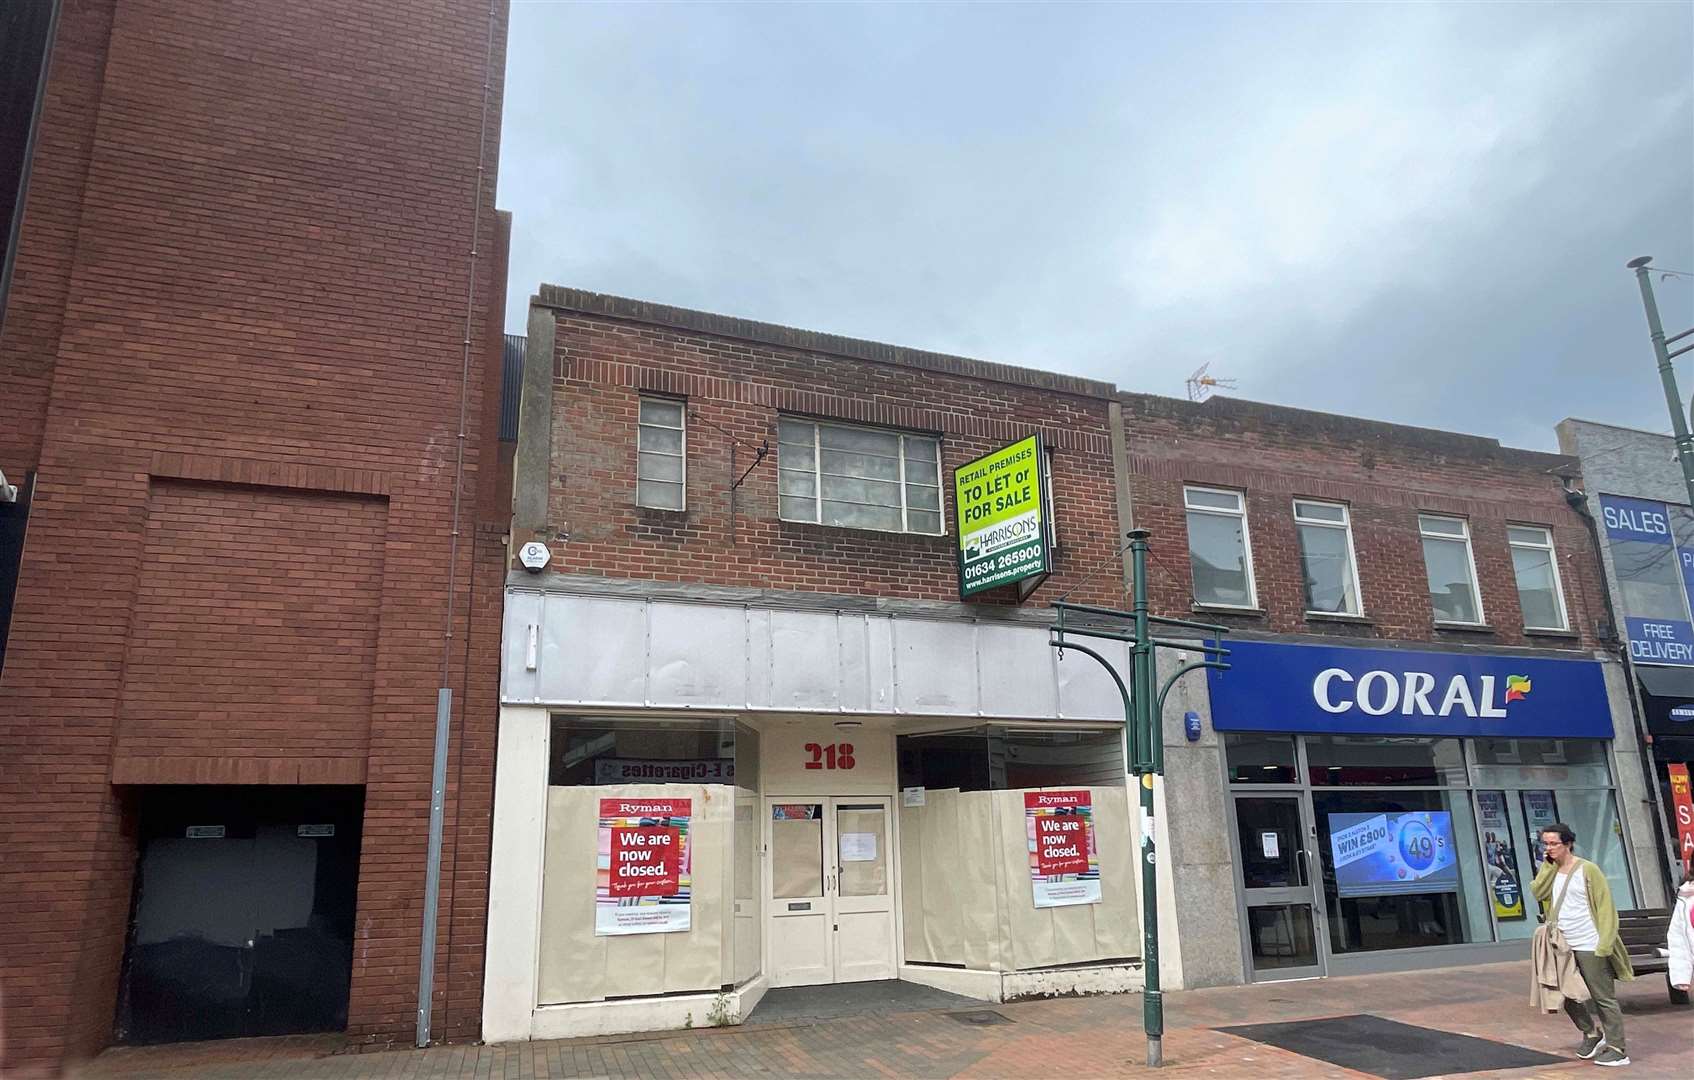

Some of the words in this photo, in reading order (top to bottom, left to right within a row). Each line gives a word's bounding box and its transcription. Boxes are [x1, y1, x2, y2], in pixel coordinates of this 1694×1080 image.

[959, 468, 987, 486] RETAIL
[989, 448, 1032, 474] PREMISES
[964, 485, 982, 504] TO
[987, 473, 1011, 496] LET
[1016, 468, 1030, 483] or
[965, 504, 991, 524] FOR
[996, 486, 1031, 513] SALE
[980, 516, 1037, 549] HARRISONS
[1604, 506, 1667, 535] SALES
[965, 558, 995, 579] 01634
[998, 546, 1041, 569] 265900
[966, 560, 1042, 589] www.harrisons.property
[1643, 623, 1675, 640] FREE
[1630, 640, 1694, 661] DELIVERY
[1313, 668, 1507, 718] CORAL
[804, 743, 856, 770] 218
[619, 803, 673, 814] Ryman
[1039, 795, 1077, 804] Ryman
[1042, 820, 1060, 832] We
[1062, 821, 1079, 831] are
[620, 832, 645, 846] We
[648, 834, 671, 846] are
[1043, 835, 1066, 845] now
[1337, 838, 1359, 855] WIN
[1360, 827, 1386, 847] £800
[620, 850, 652, 861] now
[1044, 845, 1080, 858] closed.
[619, 861, 668, 877] closed.
